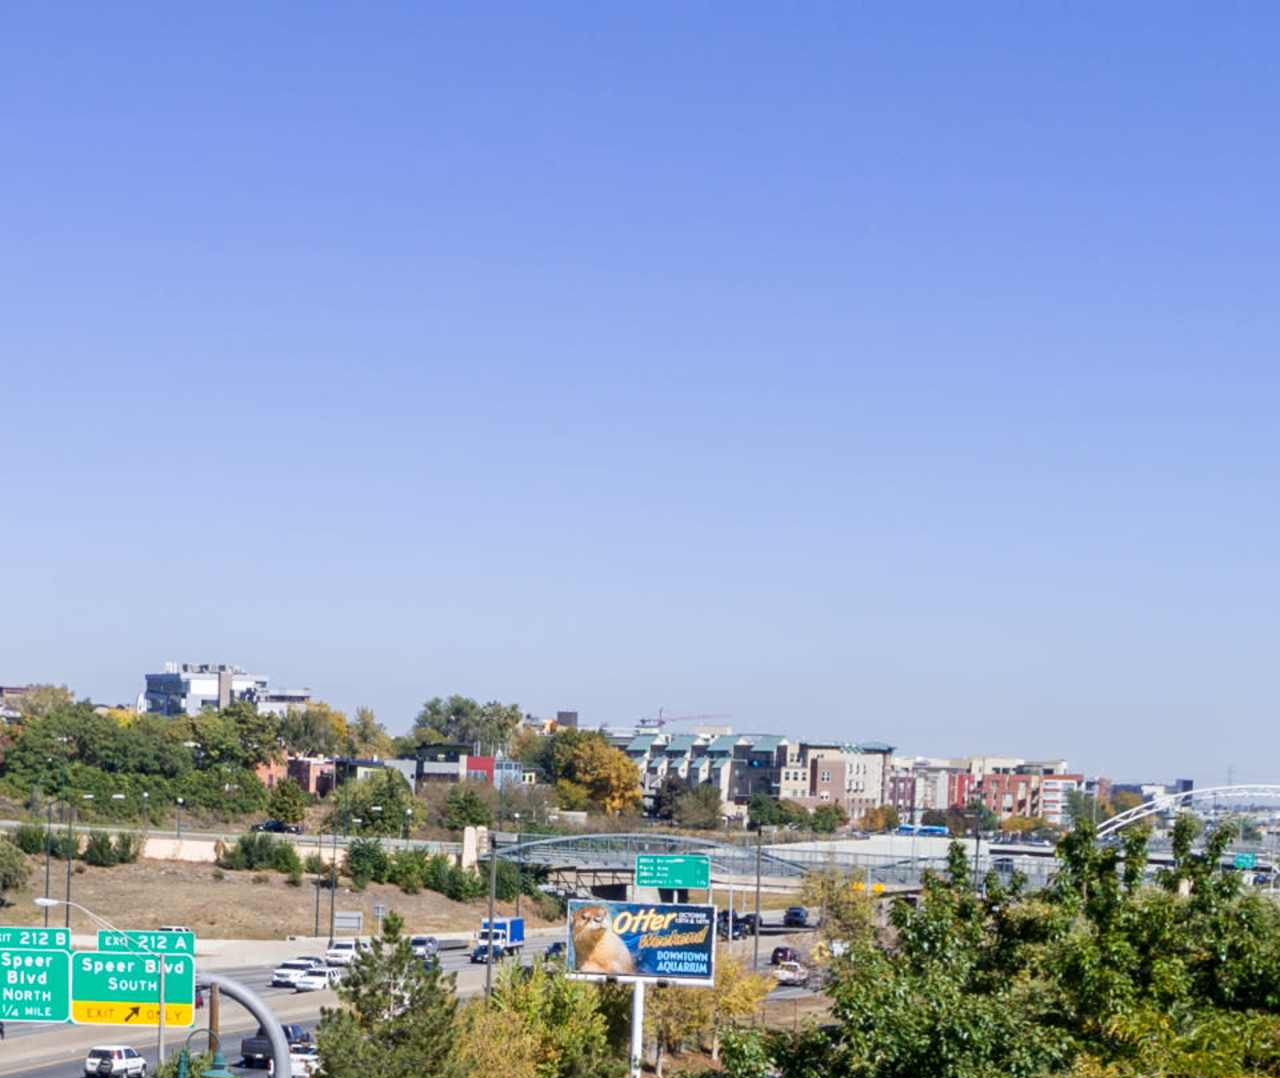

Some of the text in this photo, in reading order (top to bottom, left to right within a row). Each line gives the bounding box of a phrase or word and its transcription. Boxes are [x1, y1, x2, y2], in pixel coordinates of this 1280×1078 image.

[613, 908, 678, 934] Otter
[20, 932, 49, 945] 212
[56, 932, 67, 945] B
[138, 935, 168, 949] 212
[175, 936, 187, 949] A
[1, 952, 53, 969] Speer
[657, 951, 708, 961] DOWNTOWN
[82, 958, 135, 974] Speer
[657, 962, 707, 974] AQUARIUM
[7, 971, 47, 985] Blvd
[108, 977, 157, 991] SOUTH
[3, 987, 51, 1001] NORTH
[25, 1006, 51, 1017] MILE
[86, 1008, 114, 1018] EXIT
